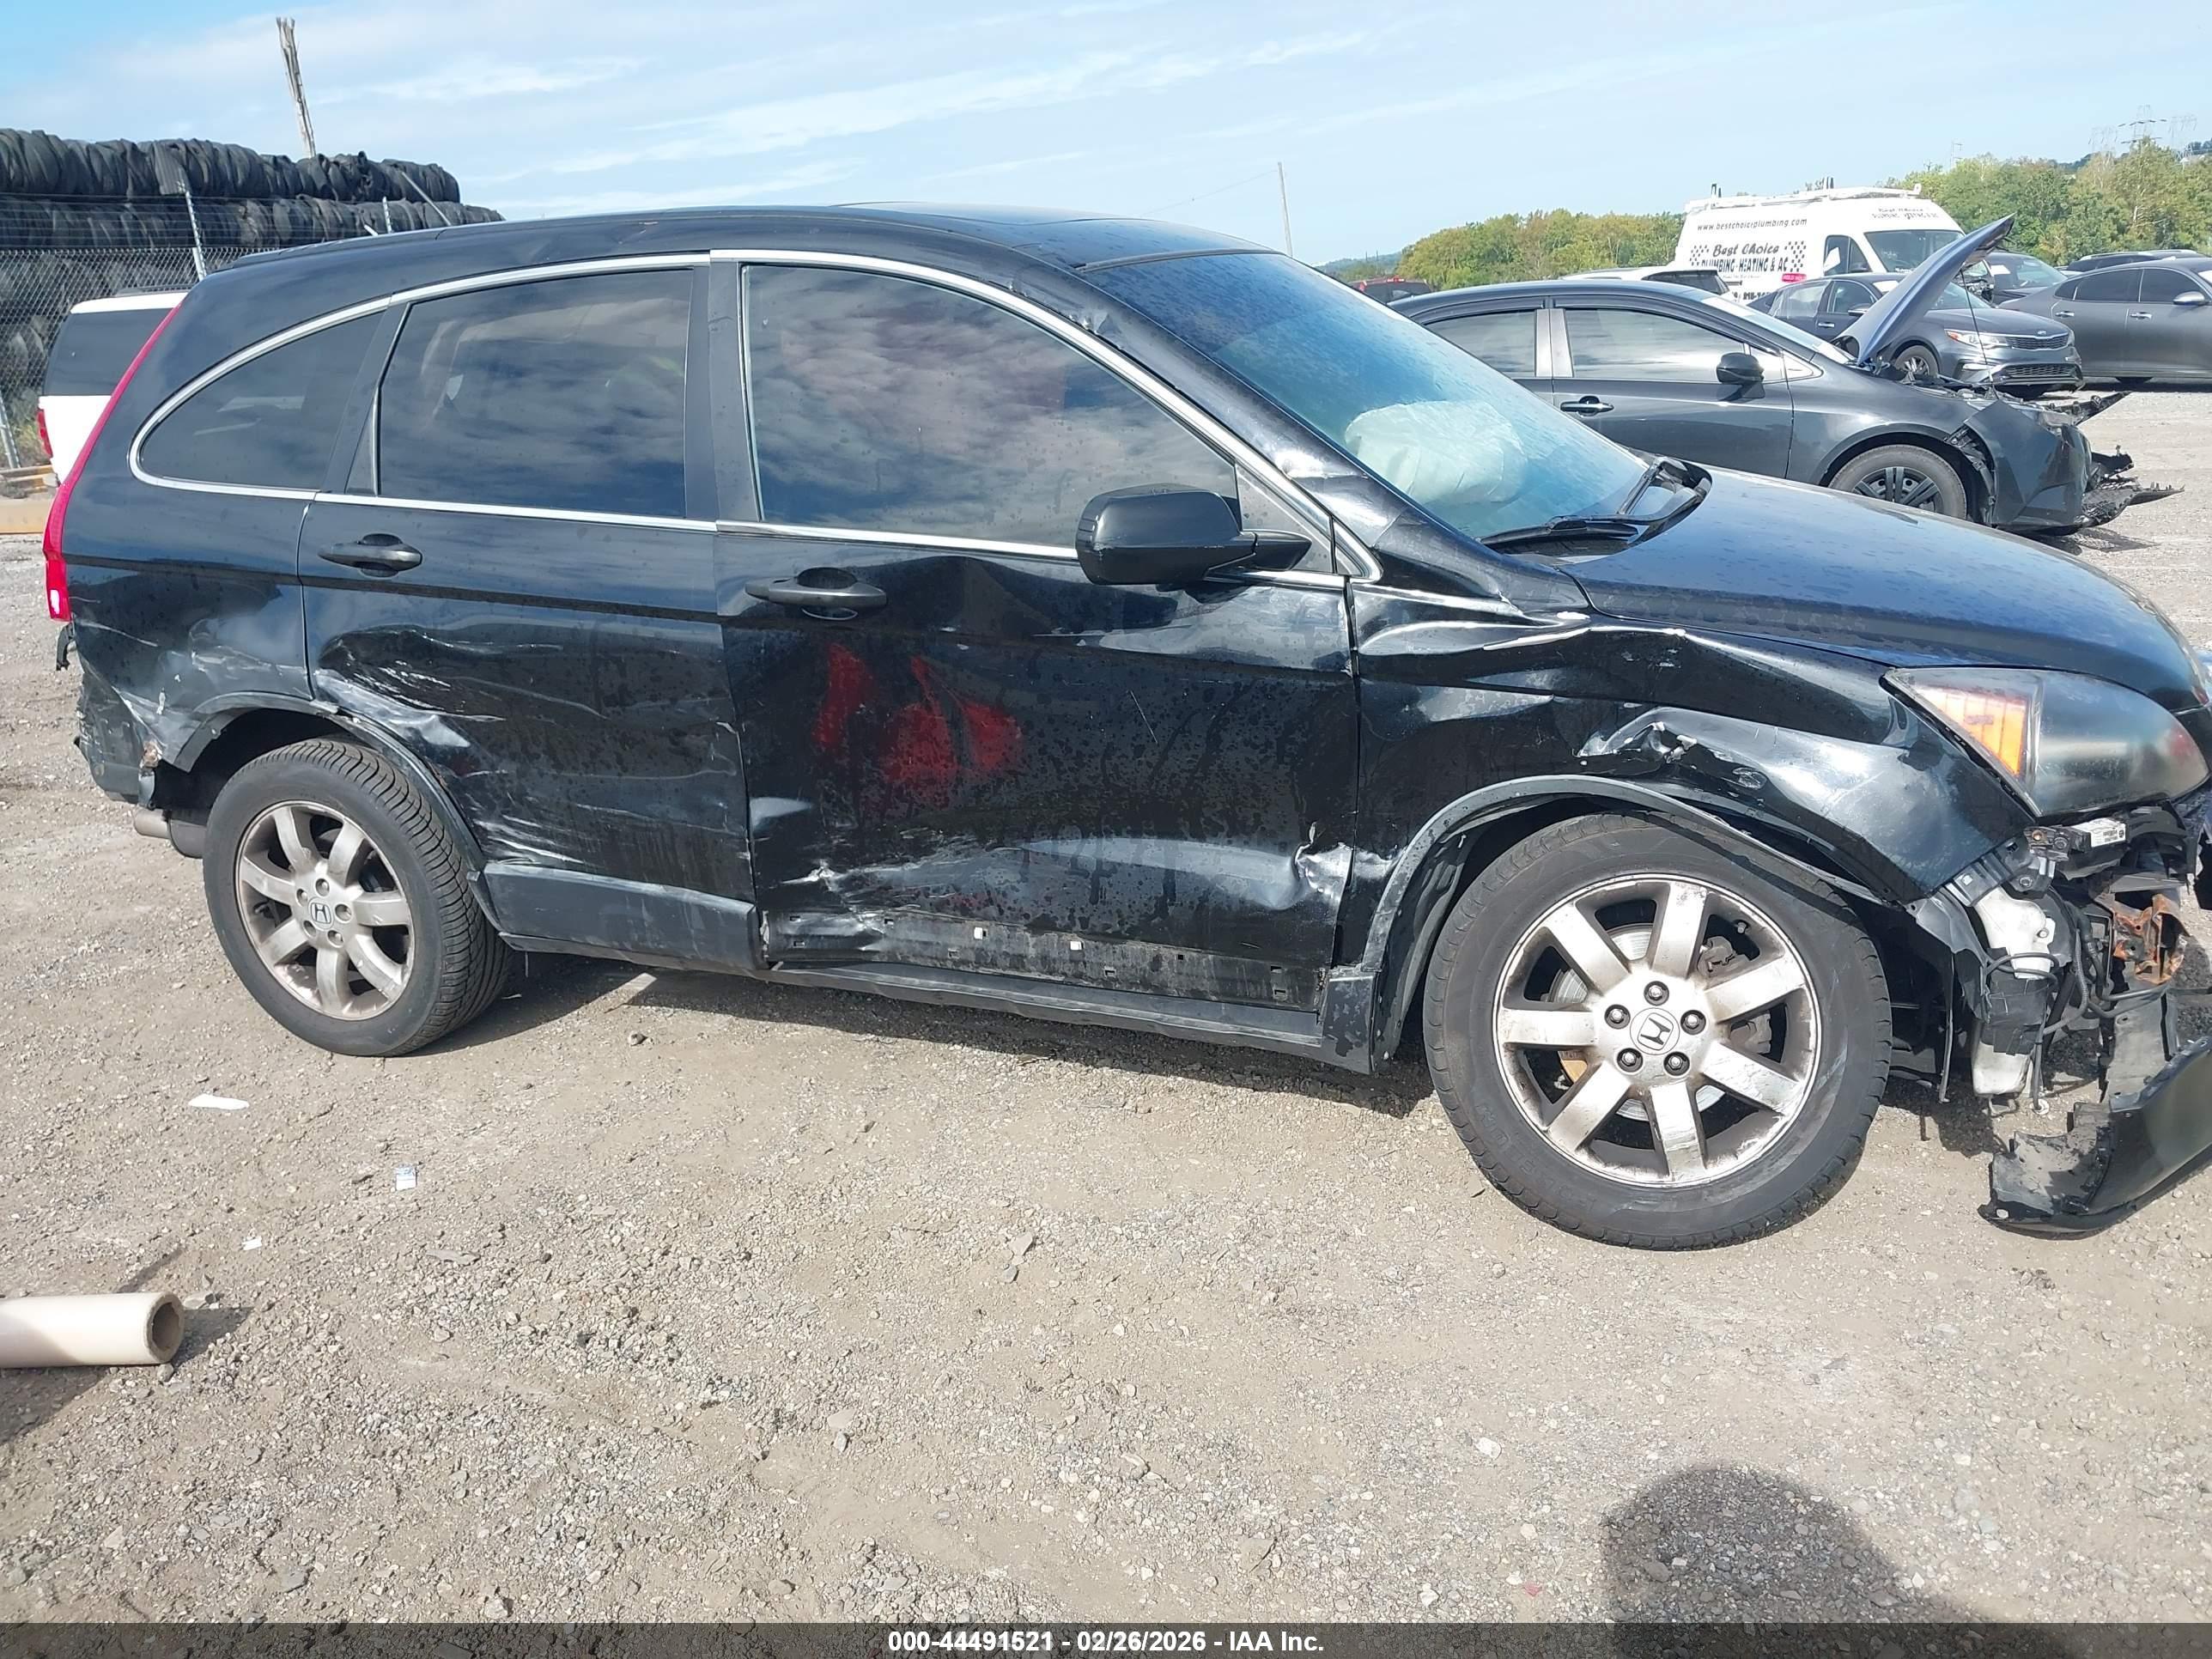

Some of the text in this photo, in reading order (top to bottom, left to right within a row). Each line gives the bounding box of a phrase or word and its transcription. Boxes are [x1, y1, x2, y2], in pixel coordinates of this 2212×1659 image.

[1712, 242, 1779, 257] Best Choice
[1770, 257, 1776, 272] &
[1778, 257, 1789, 272] AC
